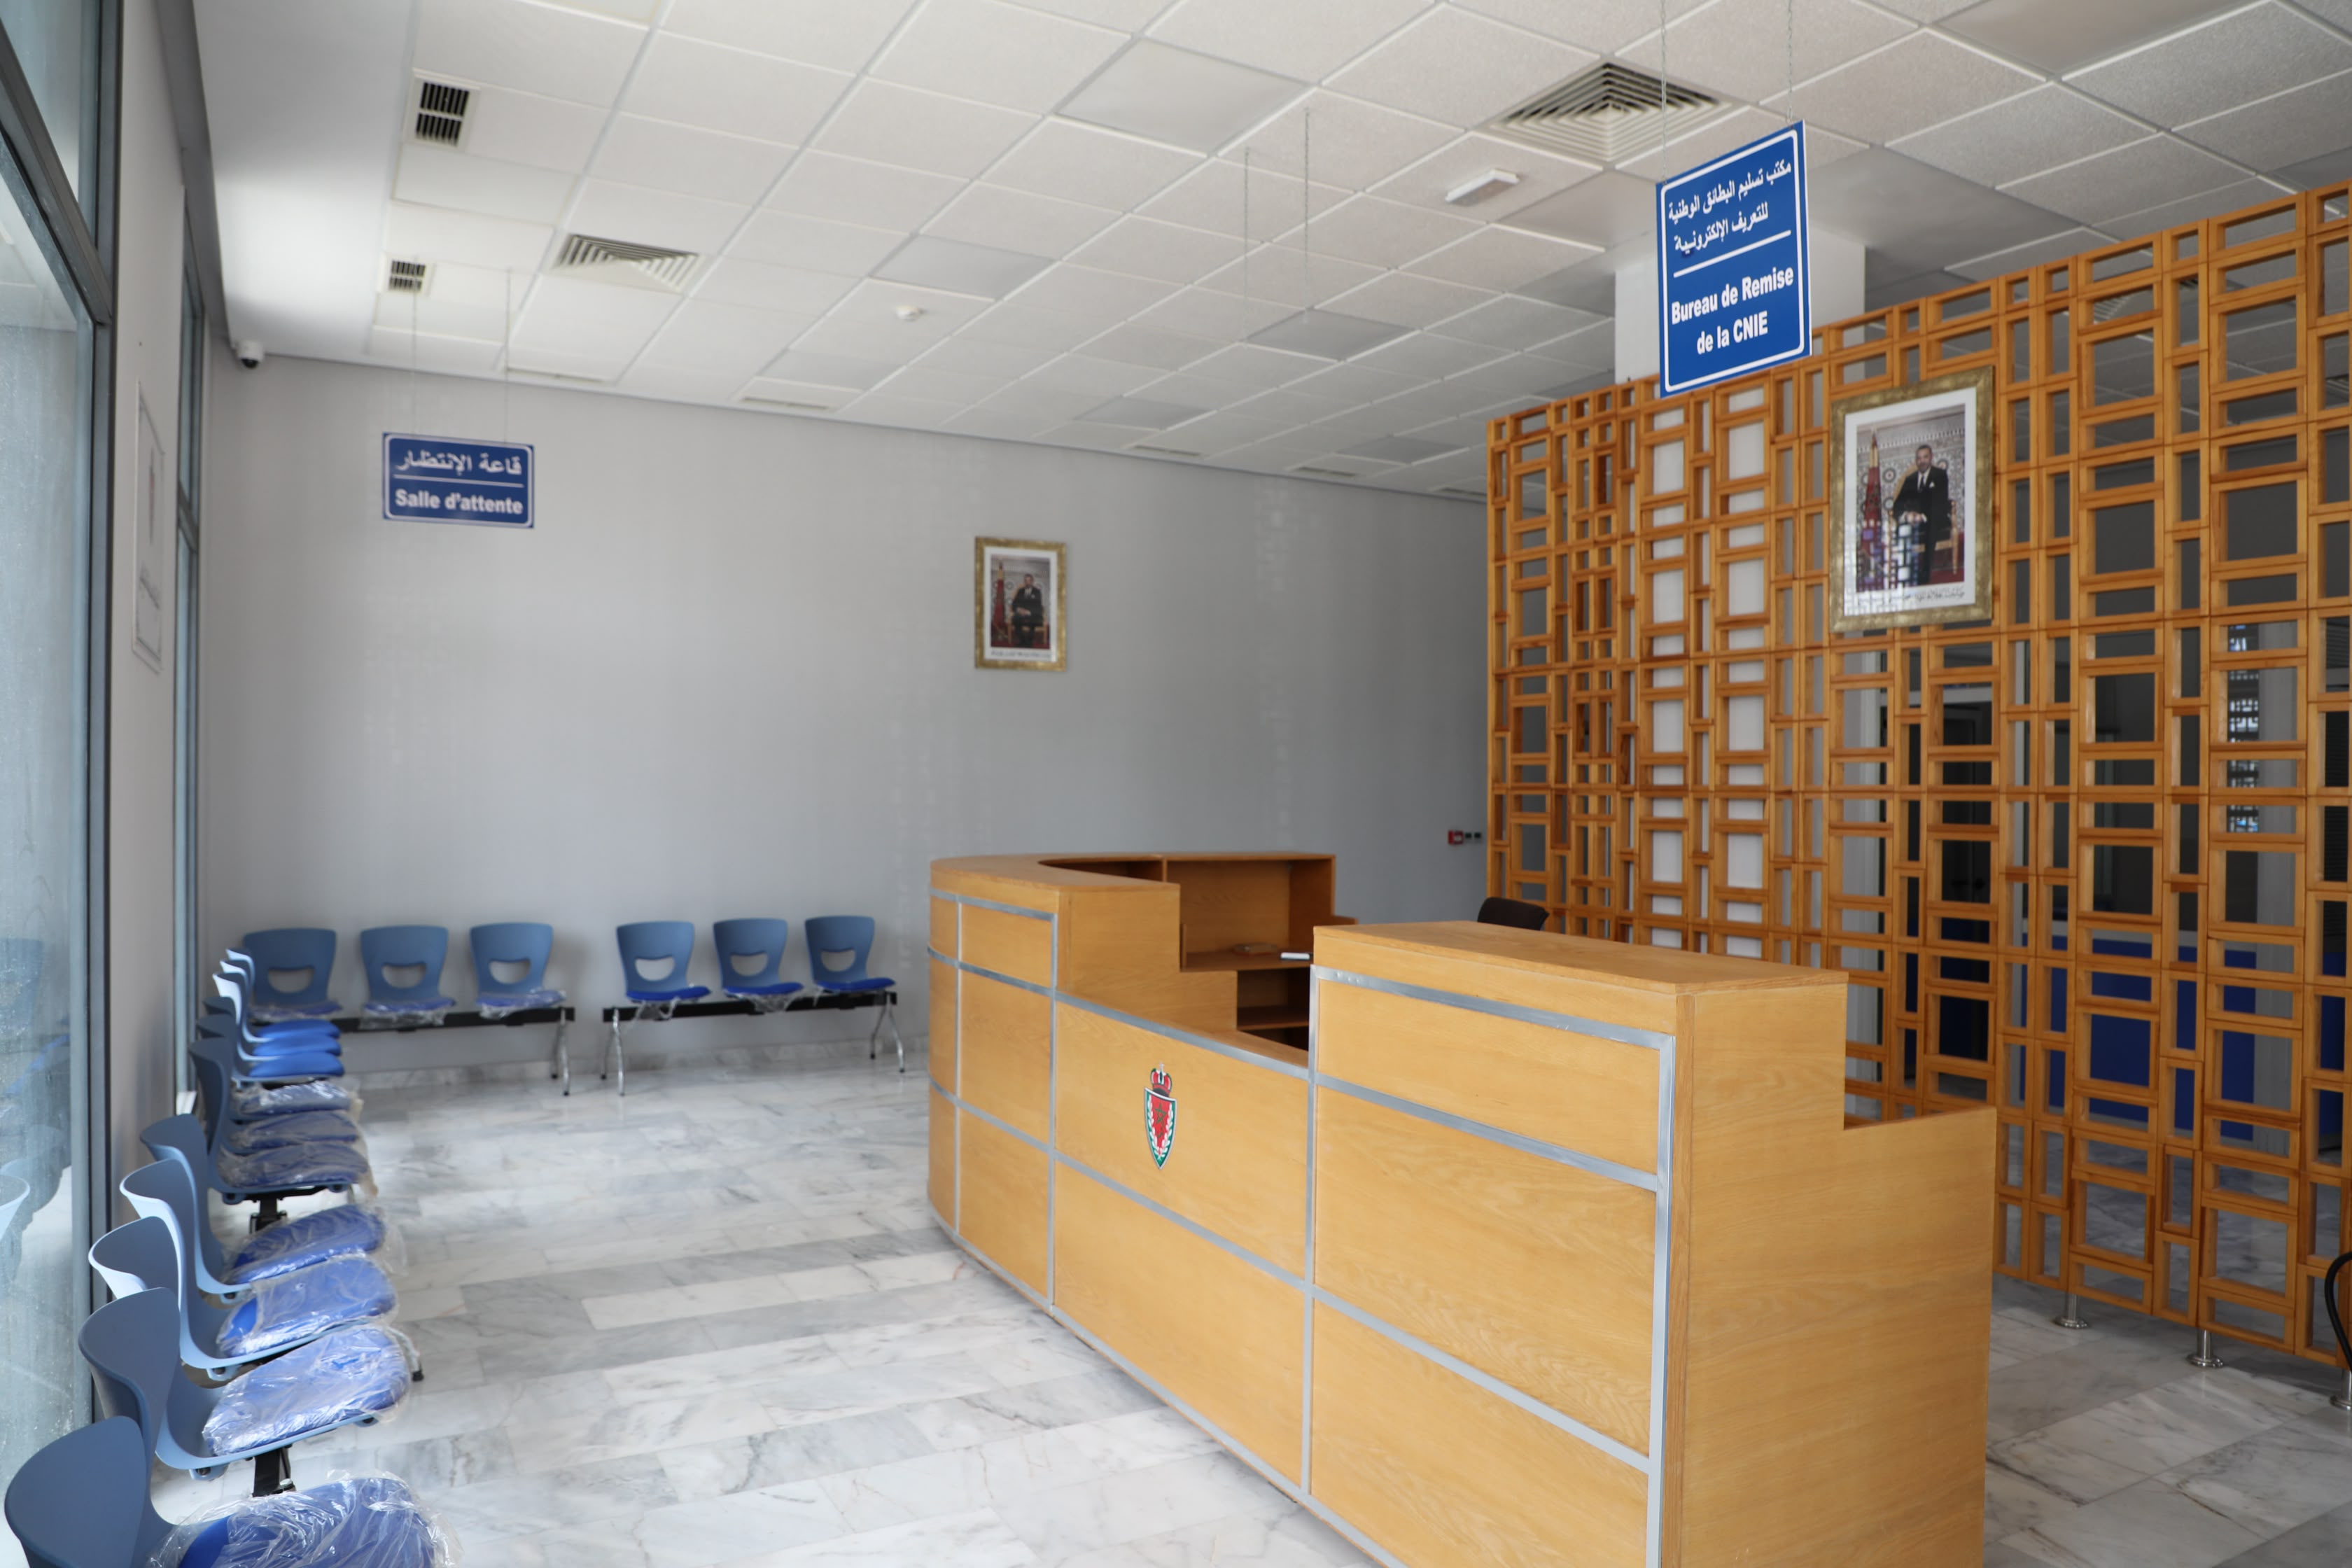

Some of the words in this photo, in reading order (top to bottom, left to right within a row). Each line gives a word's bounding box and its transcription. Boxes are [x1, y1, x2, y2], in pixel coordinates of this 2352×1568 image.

[1737, 167, 1764, 201] تسليم
[1766, 160, 1792, 186] مكتب
[1669, 195, 1700, 225] الوطنية
[1703, 180, 1735, 214] البطائق
[1732, 201, 1769, 232] للتعريف
[1674, 218, 1729, 254] الإلكترونية
[1671, 293, 1718, 325] Bureau
[1721, 284, 1739, 308] de
[1742, 267, 1794, 301] Remise
[1696, 330, 1714, 355] de
[1717, 326, 1730, 349] la
[1732, 310, 1768, 343] CNIE
[478, 452, 522, 475] قاعة
[395, 489, 441, 509] Salle
[444, 492, 524, 514] d'attente
